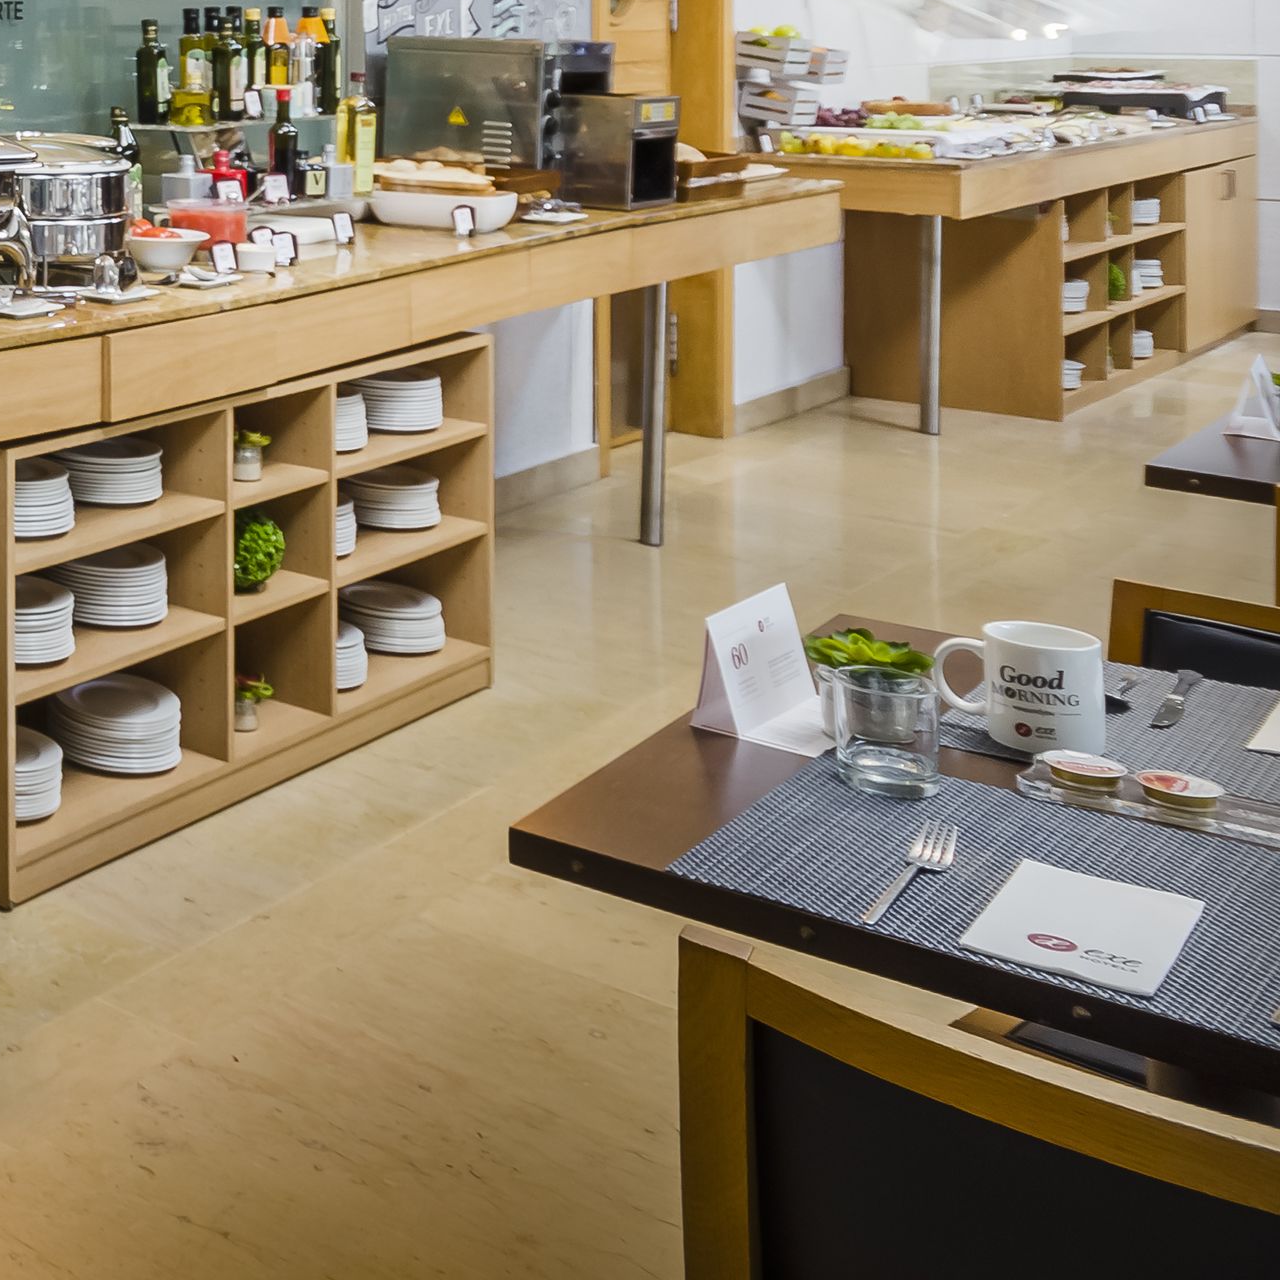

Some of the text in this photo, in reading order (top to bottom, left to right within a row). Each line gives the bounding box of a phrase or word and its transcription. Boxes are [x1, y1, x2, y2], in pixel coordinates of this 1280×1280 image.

[731, 642, 749, 670] 60
[999, 665, 1065, 690] Good
[991, 680, 1080, 707] MORNING
[1083, 949, 1143, 968] exe
